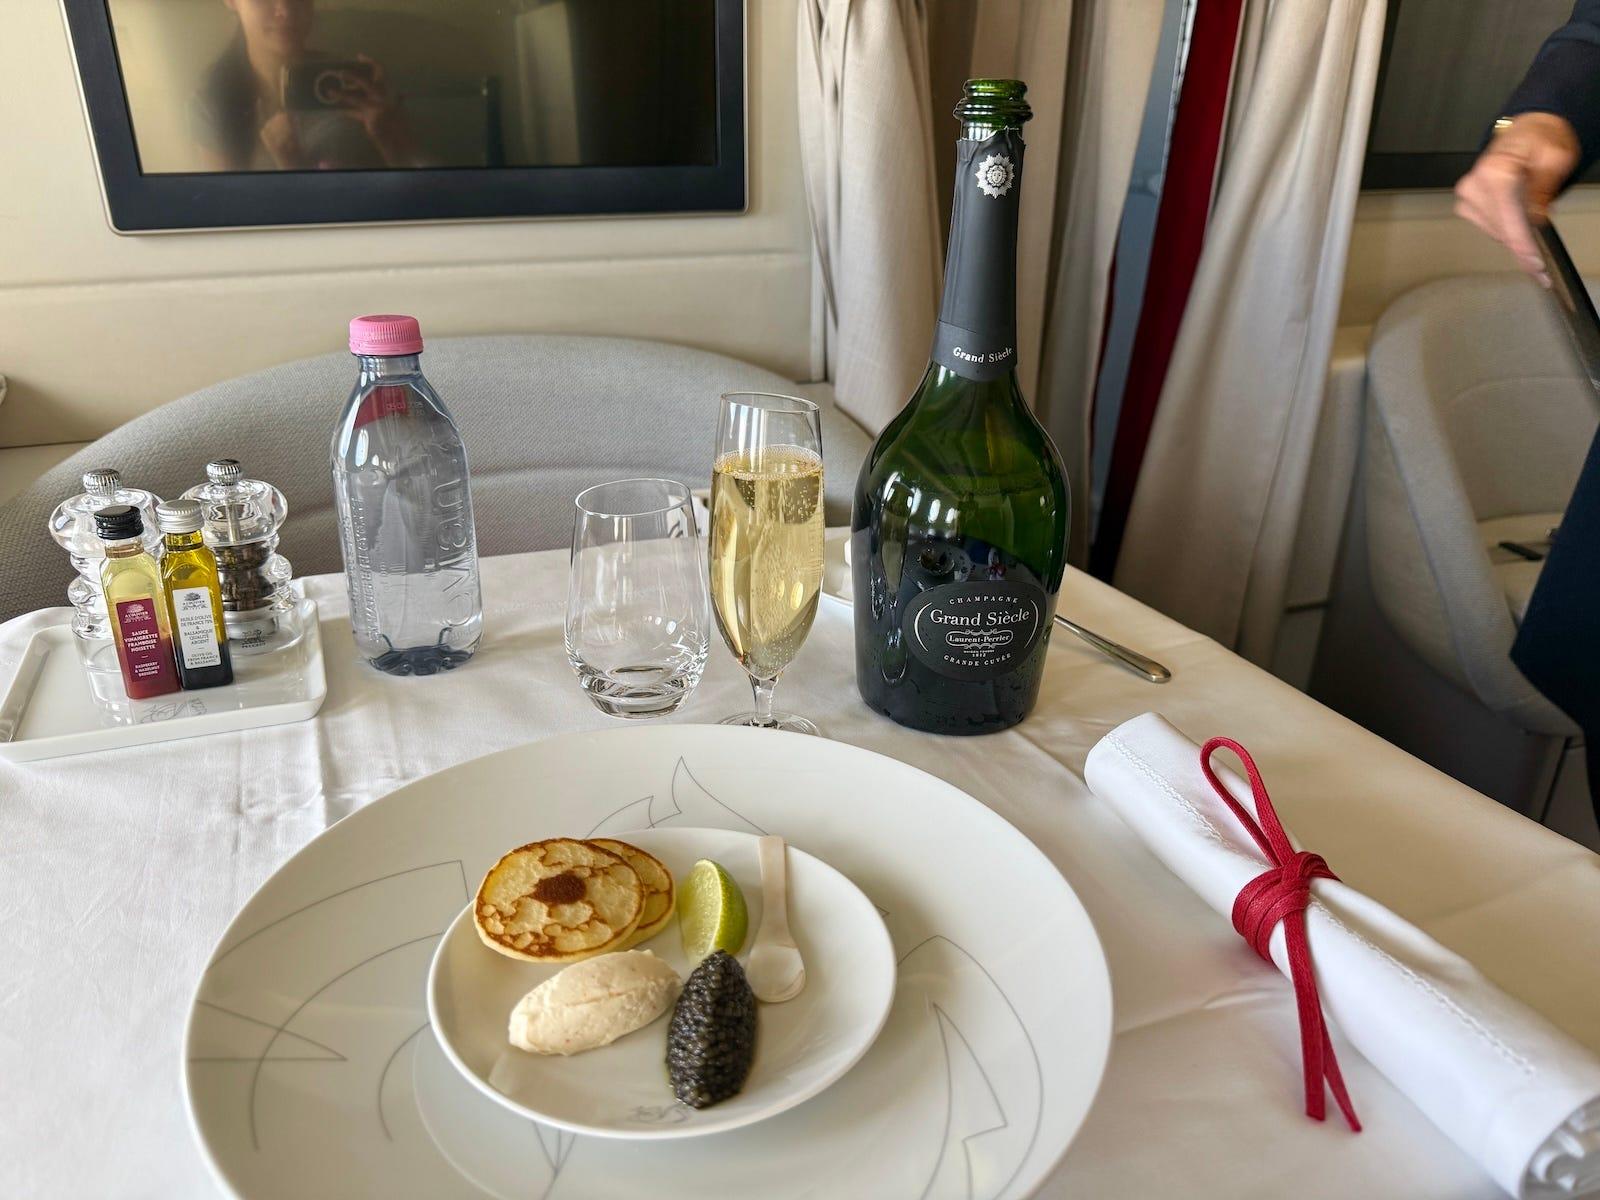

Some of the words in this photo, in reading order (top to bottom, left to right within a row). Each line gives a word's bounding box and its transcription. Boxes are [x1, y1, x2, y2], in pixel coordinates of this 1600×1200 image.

[953, 346, 985, 363] Grand
[988, 347, 1013, 363] Siècle
[949, 595, 1019, 605] CHAMPAGNE
[930, 608, 981, 627] Grand
[986, 607, 1030, 626] Siècle
[124, 633, 159, 643] VINAIGRETTE
[131, 629, 149, 637] SAUCE
[948, 633, 1011, 643] Laurent-Perrier
[128, 639, 157, 648] FRAMBOISE
[130, 644, 156, 653] NOISETTE
[943, 654, 980, 667] GRANDE
